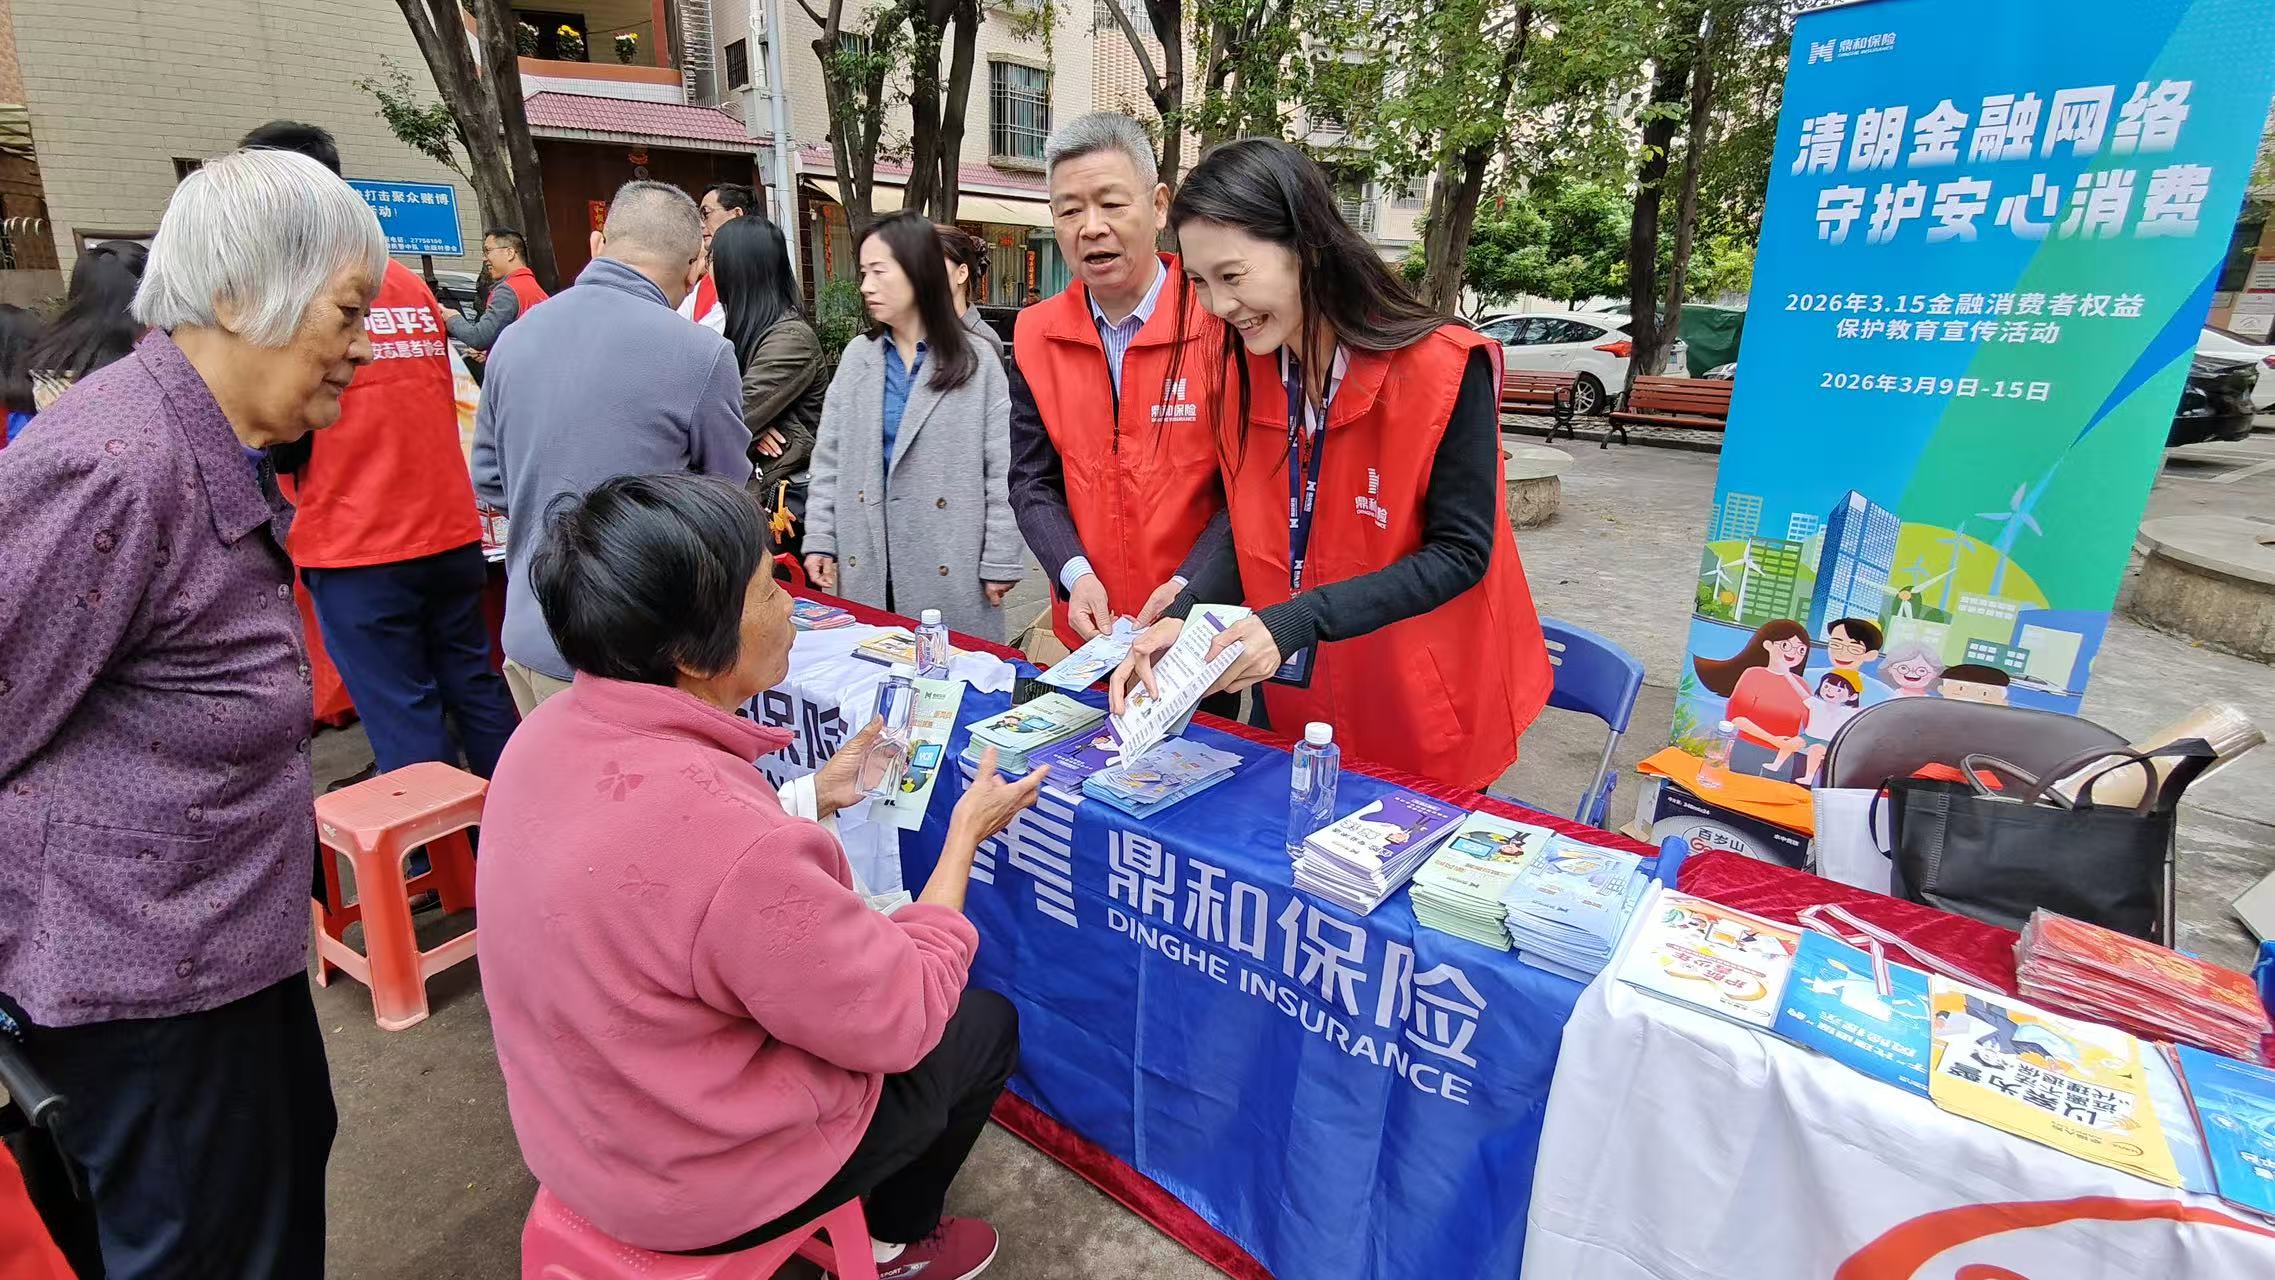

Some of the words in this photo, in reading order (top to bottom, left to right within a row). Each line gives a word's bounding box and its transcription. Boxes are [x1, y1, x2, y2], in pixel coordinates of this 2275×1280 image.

[1839, 32, 1896, 52] 鼎和保险
[1791, 79, 2194, 176] 清朗金融网络
[356, 188, 449, 206] 打击聚众赌博
[1816, 163, 2214, 247] 守护安心消费
[1785, 292, 2144, 319] 2026年3.15金融消费者权益
[1836, 319, 2061, 345] 保护教育宣传活动
[1820, 371, 2050, 402] 2026年3月9日-15日
[1355, 495, 1388, 524] 鼎和险
[1699, 828, 1744, 852] 百岁山
[1107, 829, 1488, 1068] 鼎和保险
[1107, 906, 1229, 984] DINGHE
[1239, 968, 1473, 1106] INSURANCE
[1947, 1062, 2098, 1126] 以案为警
[2015, 1073, 2117, 1114] 远离不法
[880, 1267, 902, 1278] SPORT
